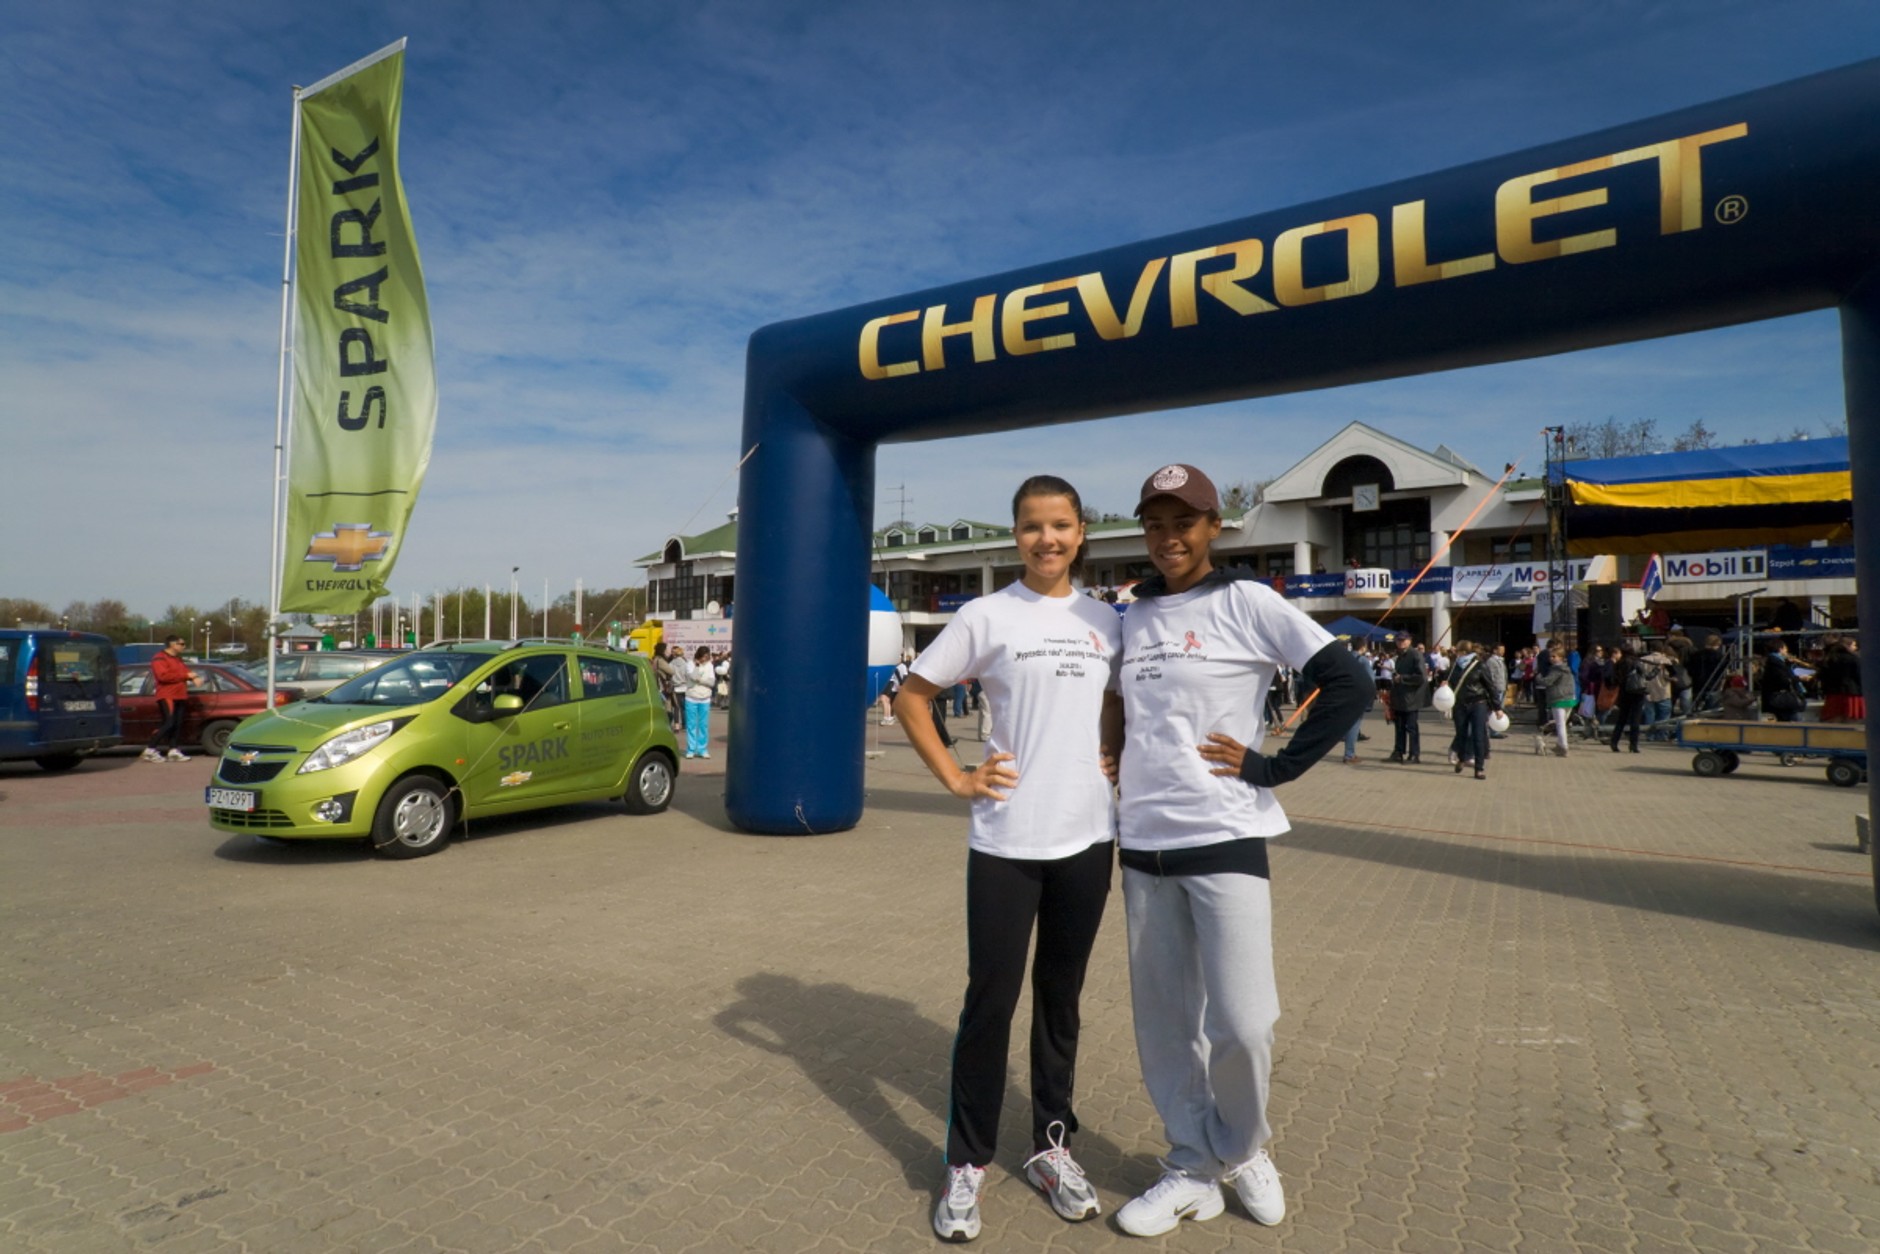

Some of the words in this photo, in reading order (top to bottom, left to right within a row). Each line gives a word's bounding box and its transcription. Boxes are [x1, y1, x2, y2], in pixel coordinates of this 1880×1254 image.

[330, 135, 389, 431] SPARK
[859, 122, 1748, 380] CHEVROLET
[1667, 557, 1736, 578] Mobil
[498, 736, 570, 770] SPARK
